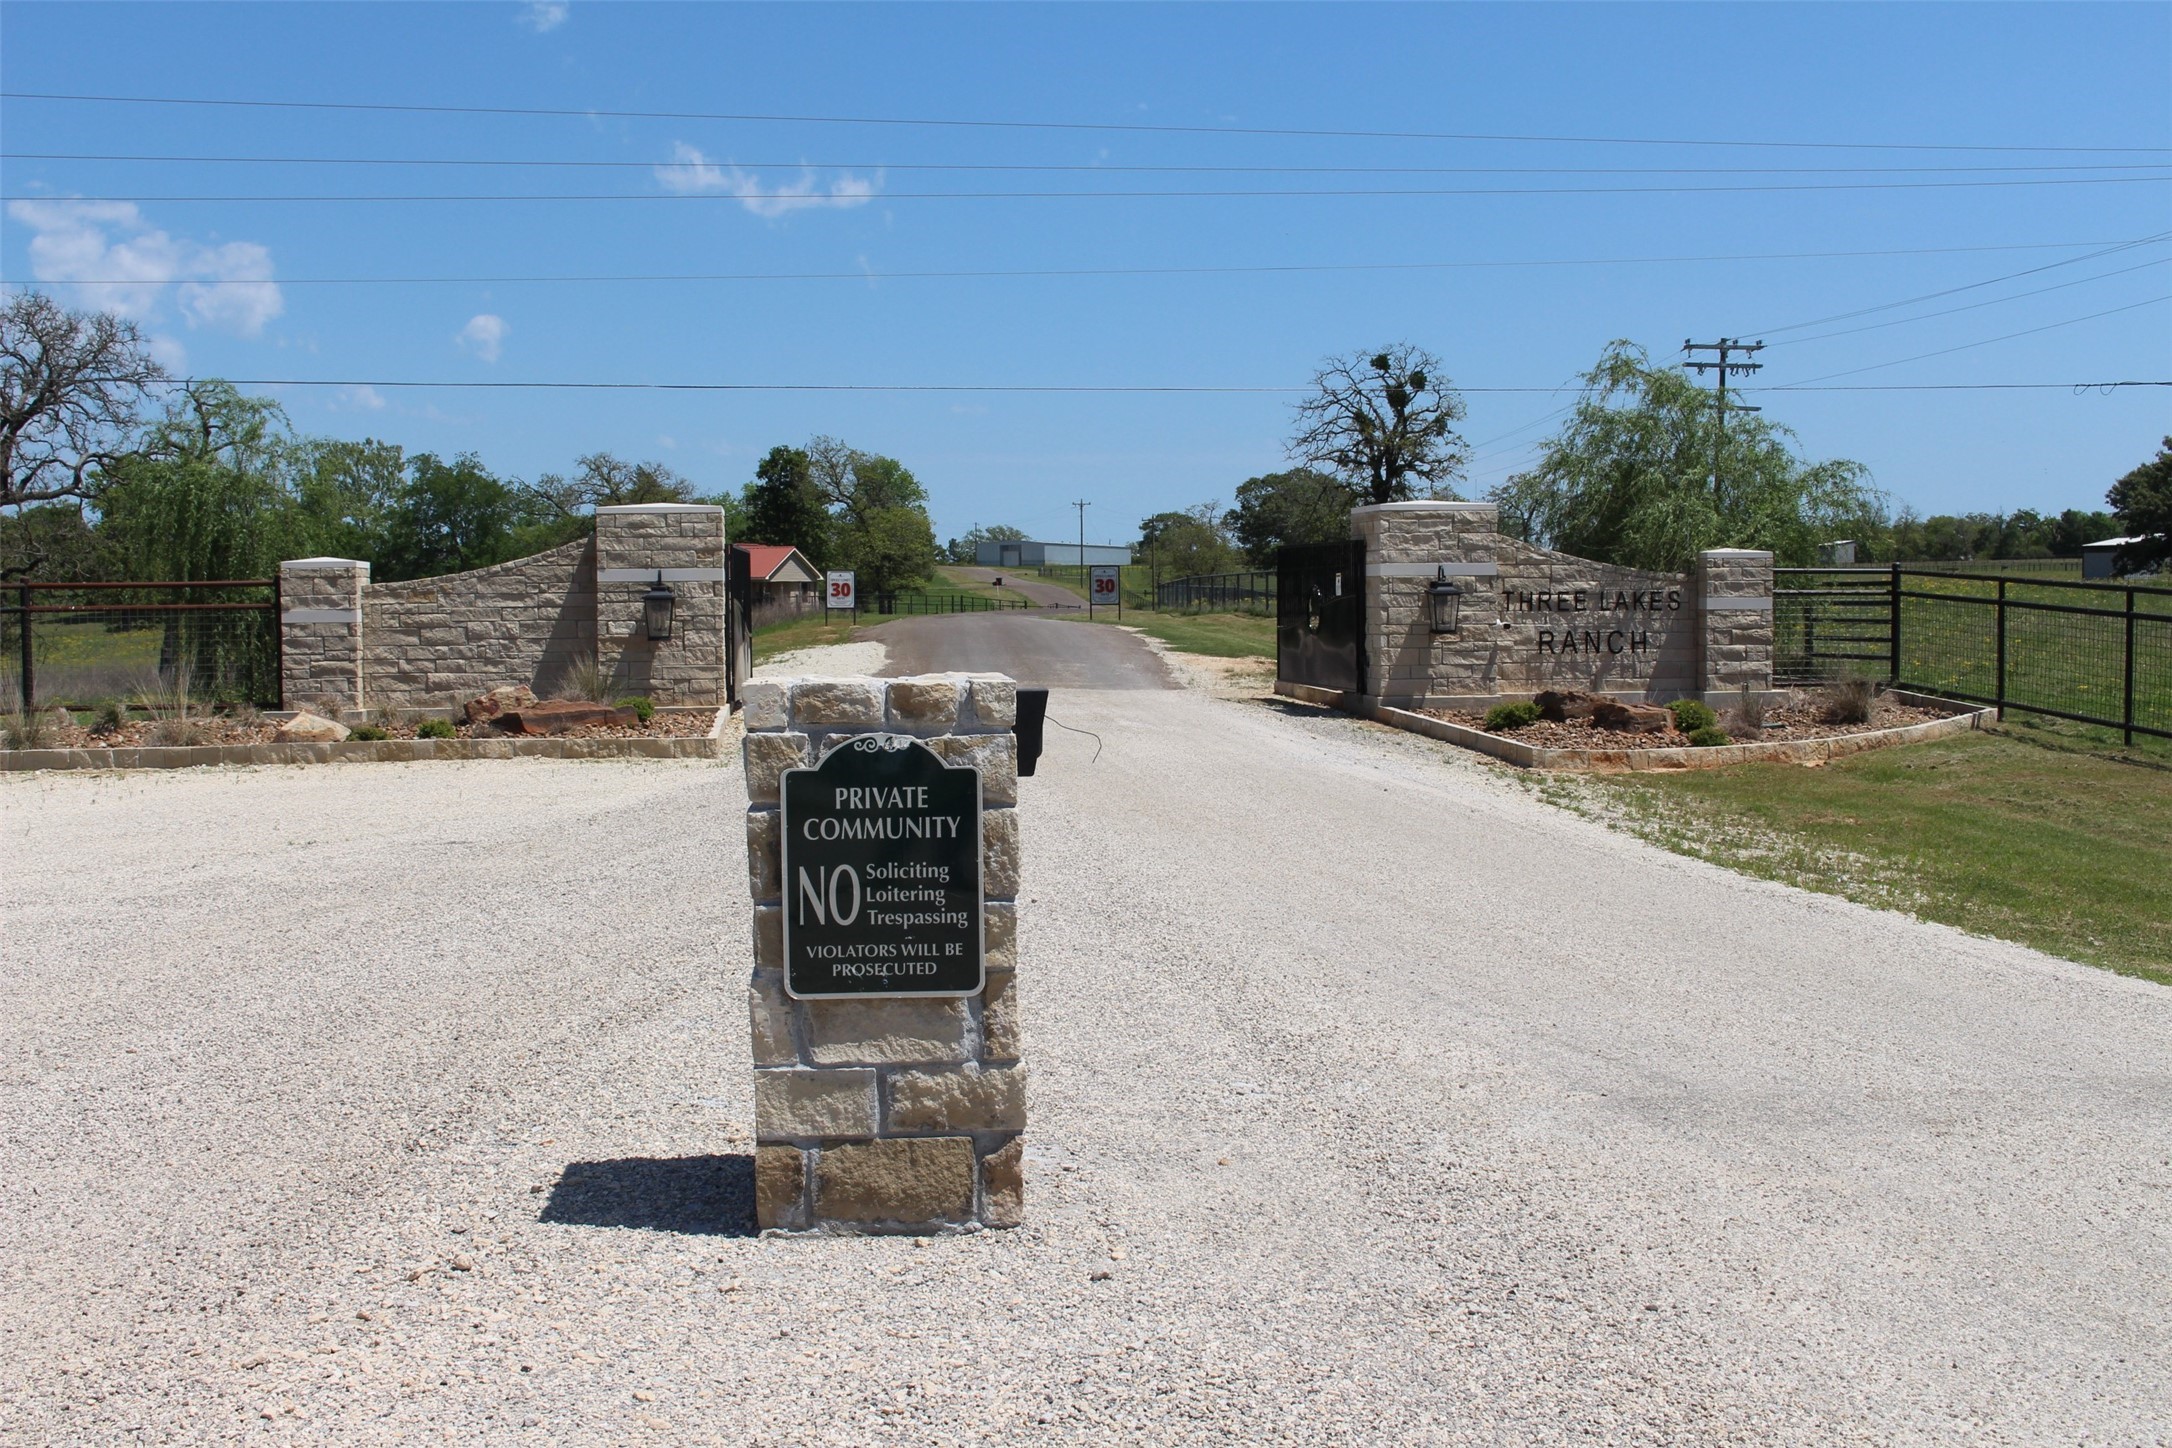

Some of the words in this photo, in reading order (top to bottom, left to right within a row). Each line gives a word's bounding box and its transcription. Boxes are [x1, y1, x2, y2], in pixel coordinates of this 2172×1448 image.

[831, 583, 851, 597] 30
[1095, 579, 1115, 593] 30
[1501, 590, 1587, 612] THREE
[1600, 590, 1682, 612] LAKES
[1538, 629, 1648, 655] RANCH
[835, 786, 929, 810] PRIVATE
[803, 816, 961, 841] COMMUNITY
[866, 861, 950, 883] Soliciting
[799, 864, 861, 927] NO
[866, 884, 946, 906] Loitering
[867, 908, 968, 930] Trespassing
[806, 944, 898, 959] VIOLATORS
[901, 943, 940, 957] WILL
[945, 942, 964, 956] BE
[832, 961, 937, 977] PROSECUTED
